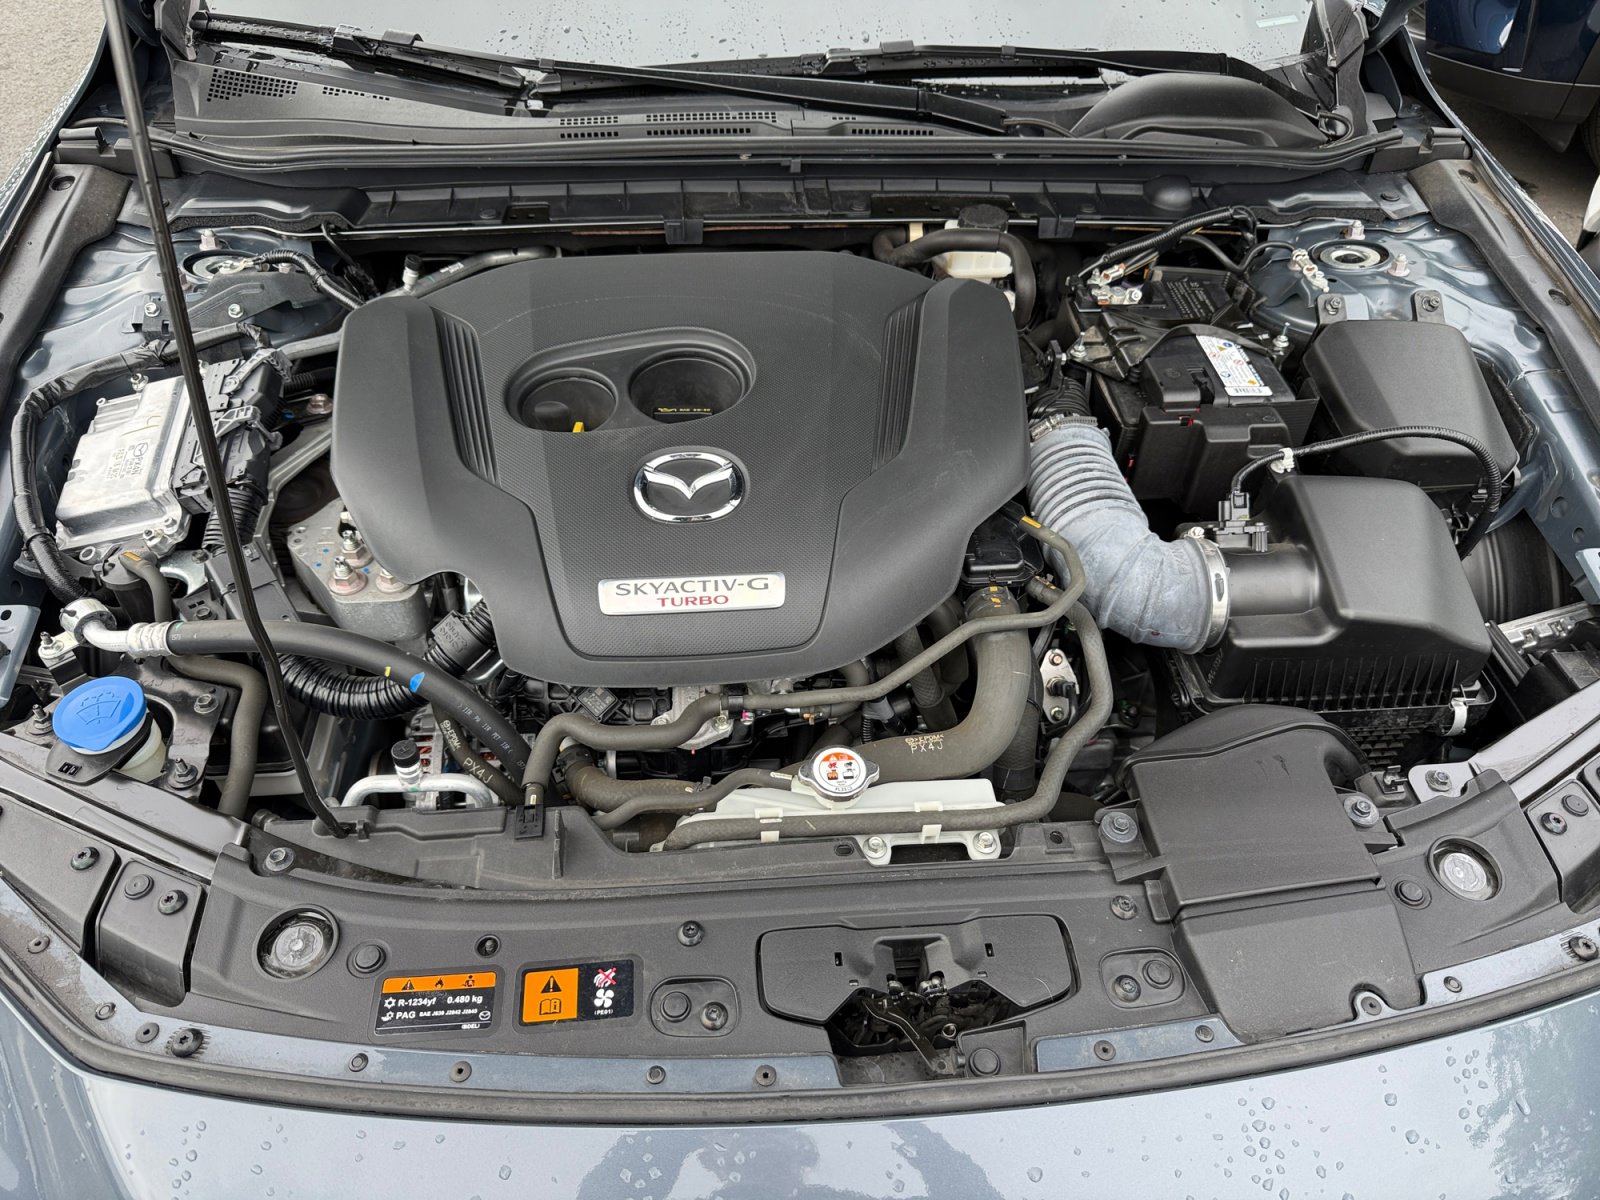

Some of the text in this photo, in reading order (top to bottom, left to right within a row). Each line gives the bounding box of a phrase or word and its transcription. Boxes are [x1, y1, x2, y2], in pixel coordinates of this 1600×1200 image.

[615, 577, 769, 596] SKYACTIV-G
[657, 595, 729, 608] TURBO
[911, 741, 943, 754] PX4J
[463, 757, 494, 784] PX4J
[397, 994, 483, 1007] R-1234yf 0.480 kg
[395, 1011, 416, 1020] PAG
